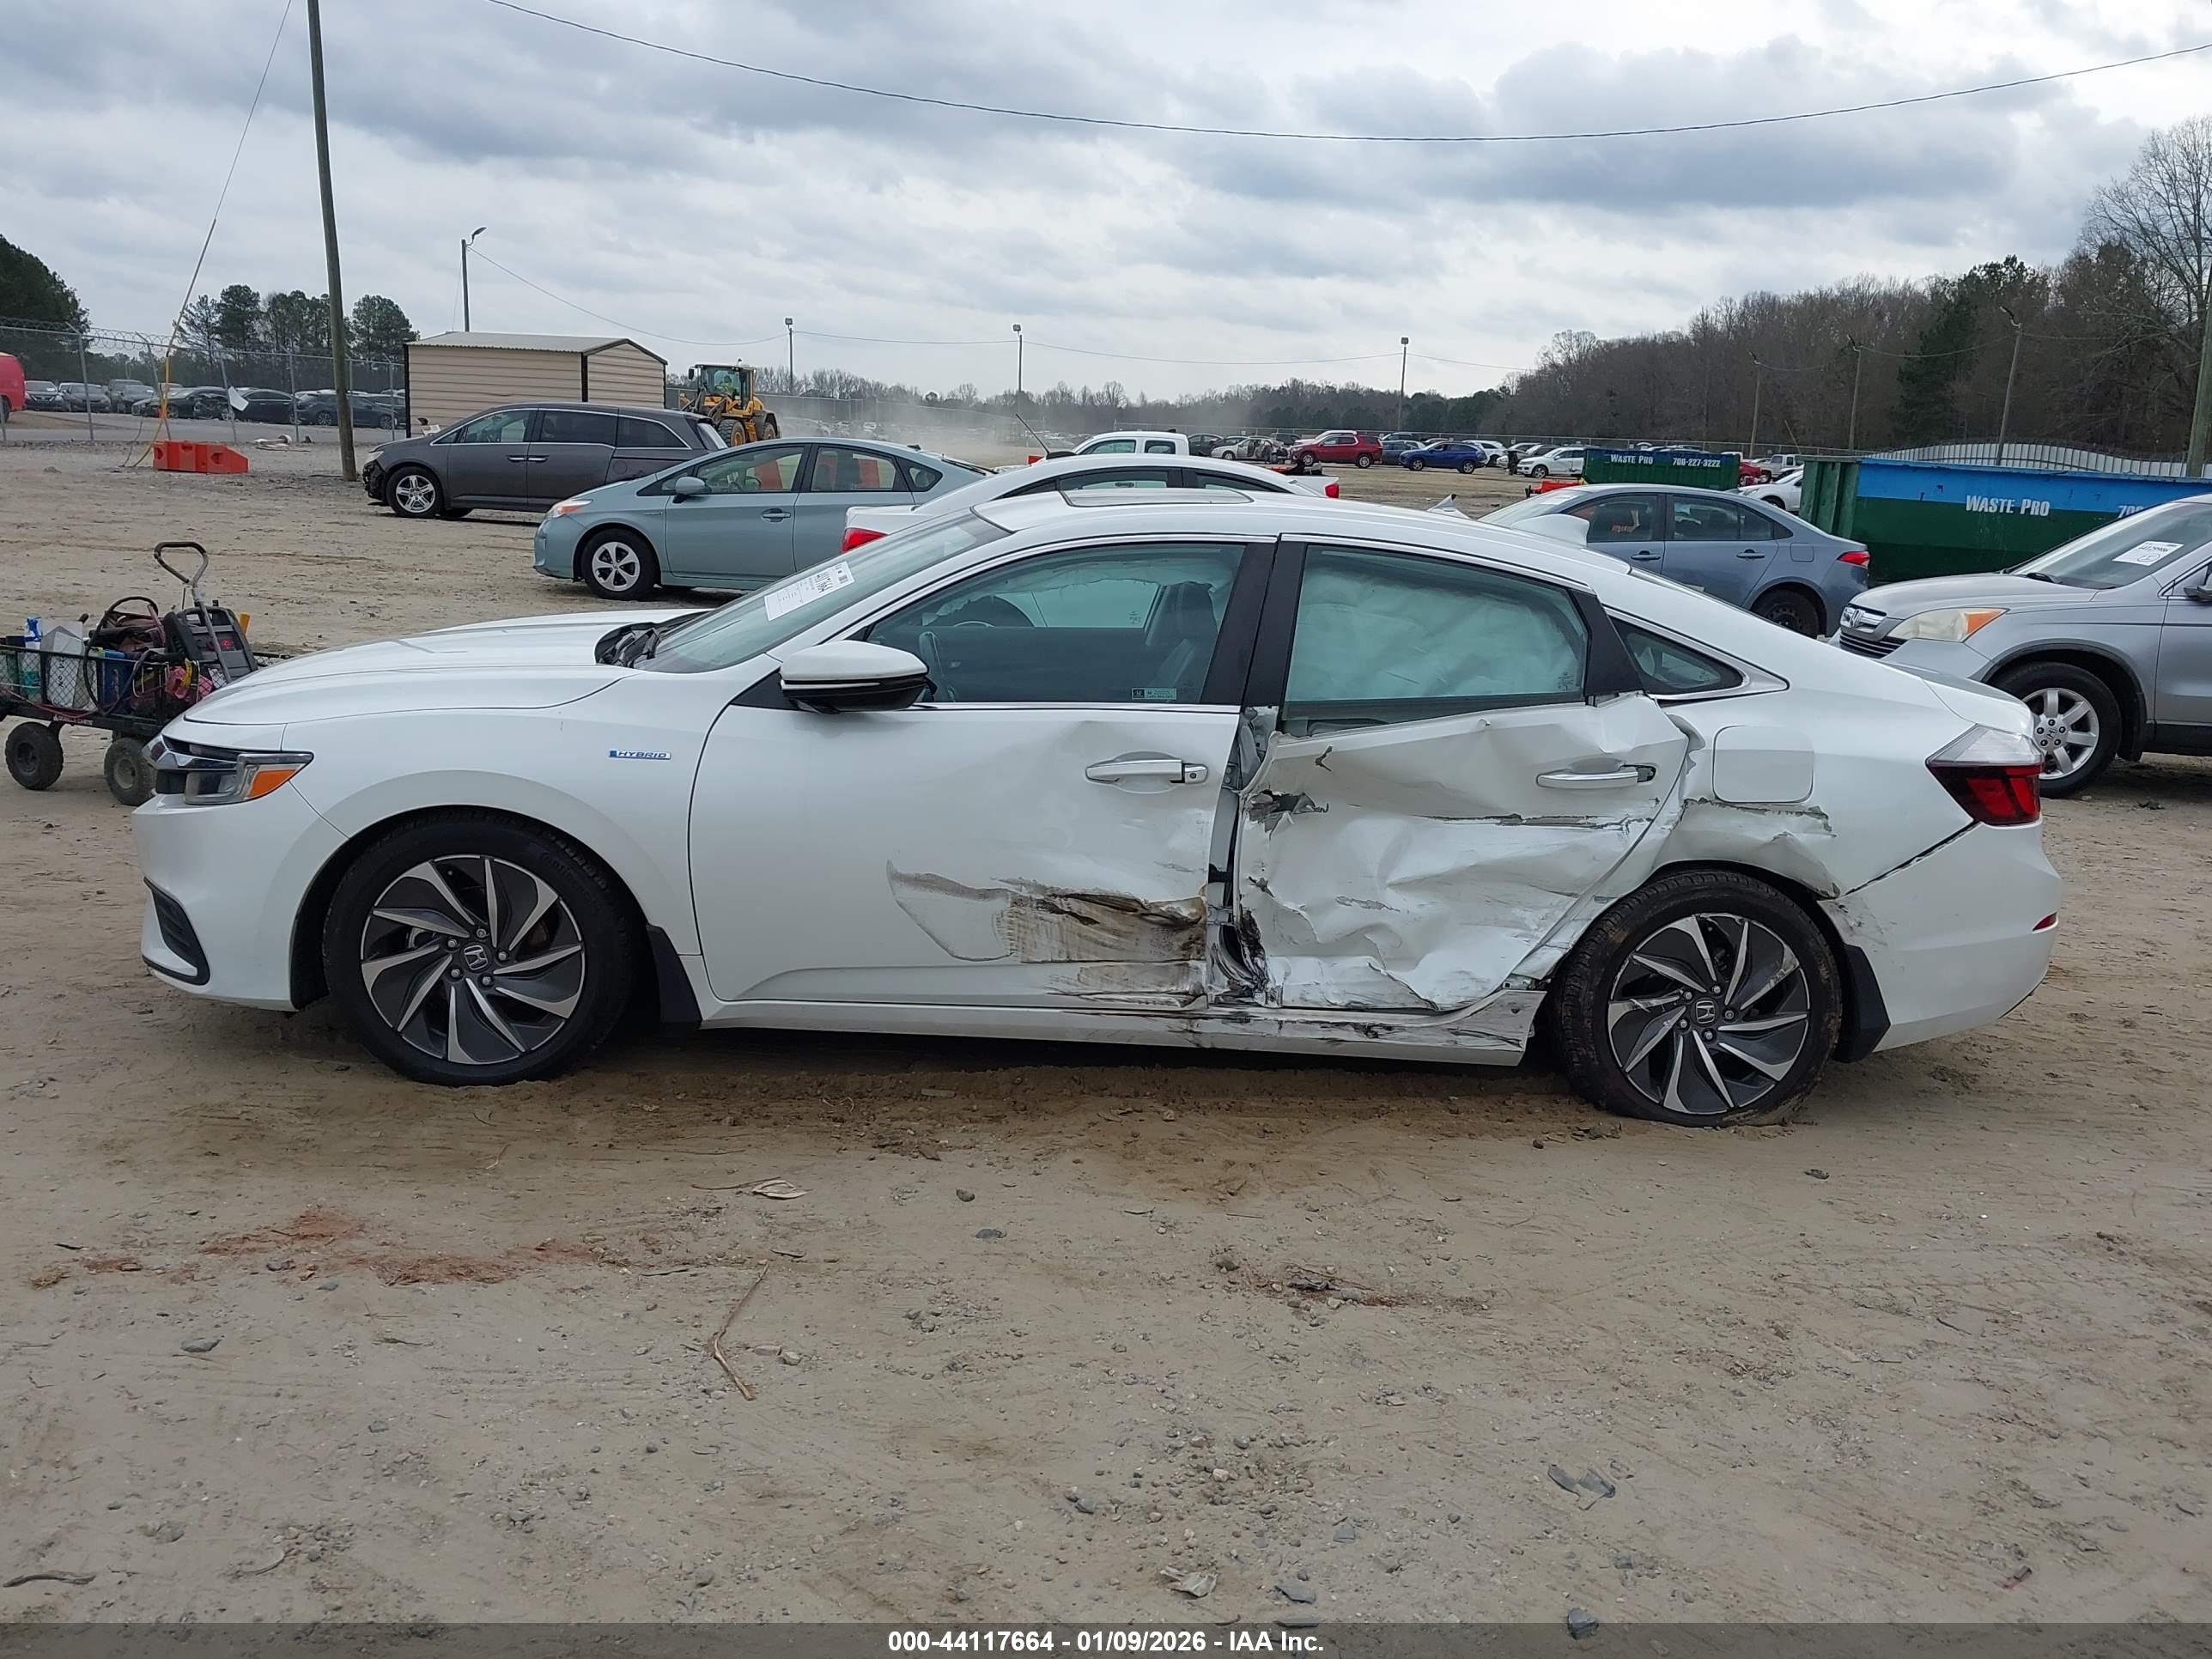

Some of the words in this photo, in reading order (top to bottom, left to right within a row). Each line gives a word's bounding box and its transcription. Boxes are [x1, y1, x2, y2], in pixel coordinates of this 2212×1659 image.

[1611, 454, 1635, 464] WASTE
[1966, 495, 2015, 514] WASTE
[2020, 499, 2051, 516] PRO
